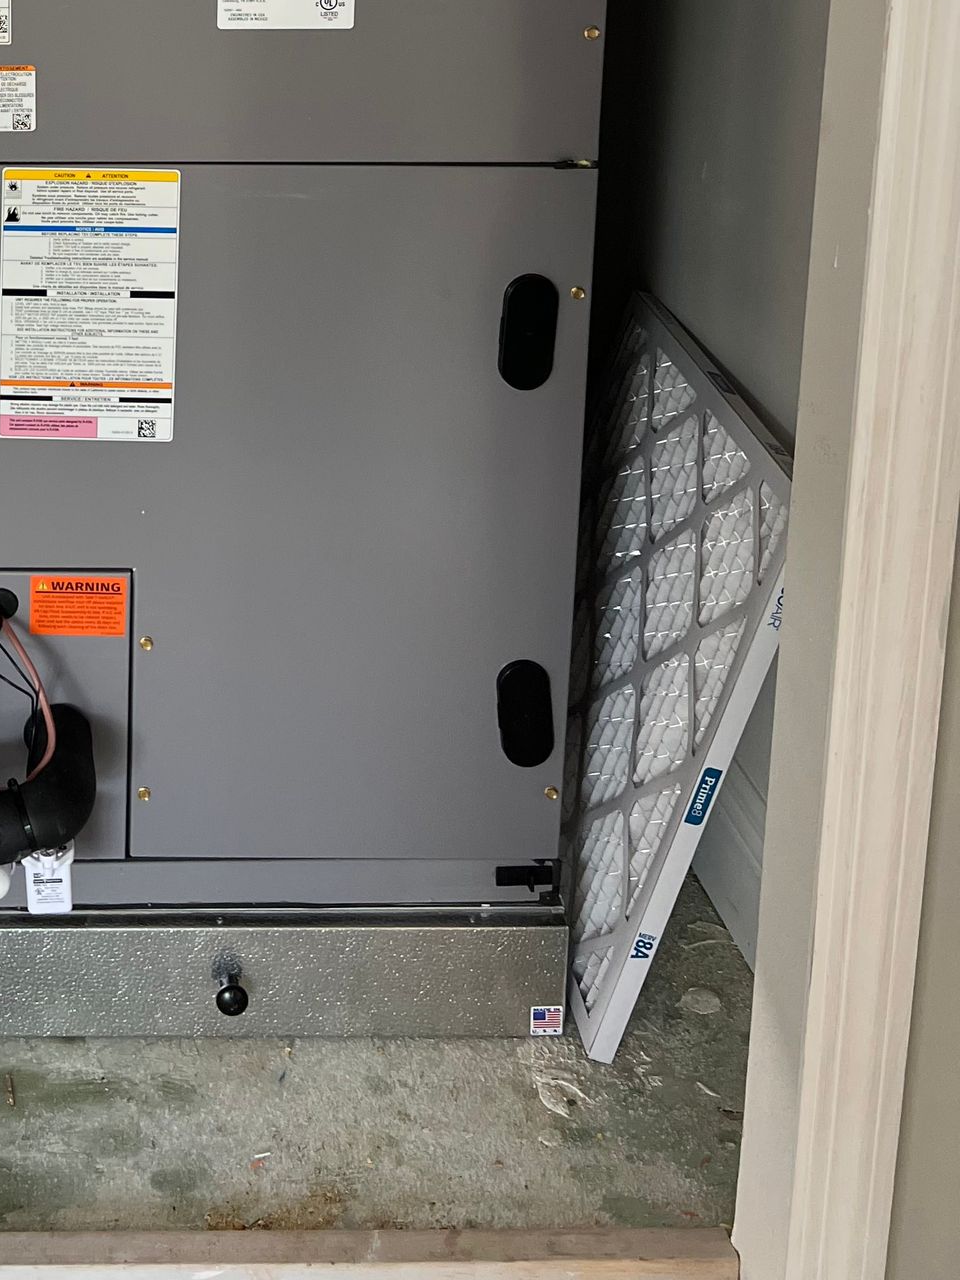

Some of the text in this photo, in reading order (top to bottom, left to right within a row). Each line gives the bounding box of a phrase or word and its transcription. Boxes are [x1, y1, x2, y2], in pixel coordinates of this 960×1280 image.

[51, 581, 121, 592] WARNING
[692, 777, 715, 817] Prime8
[639, 933, 657, 942] MERV
[631, 938, 653, 959] 8A
